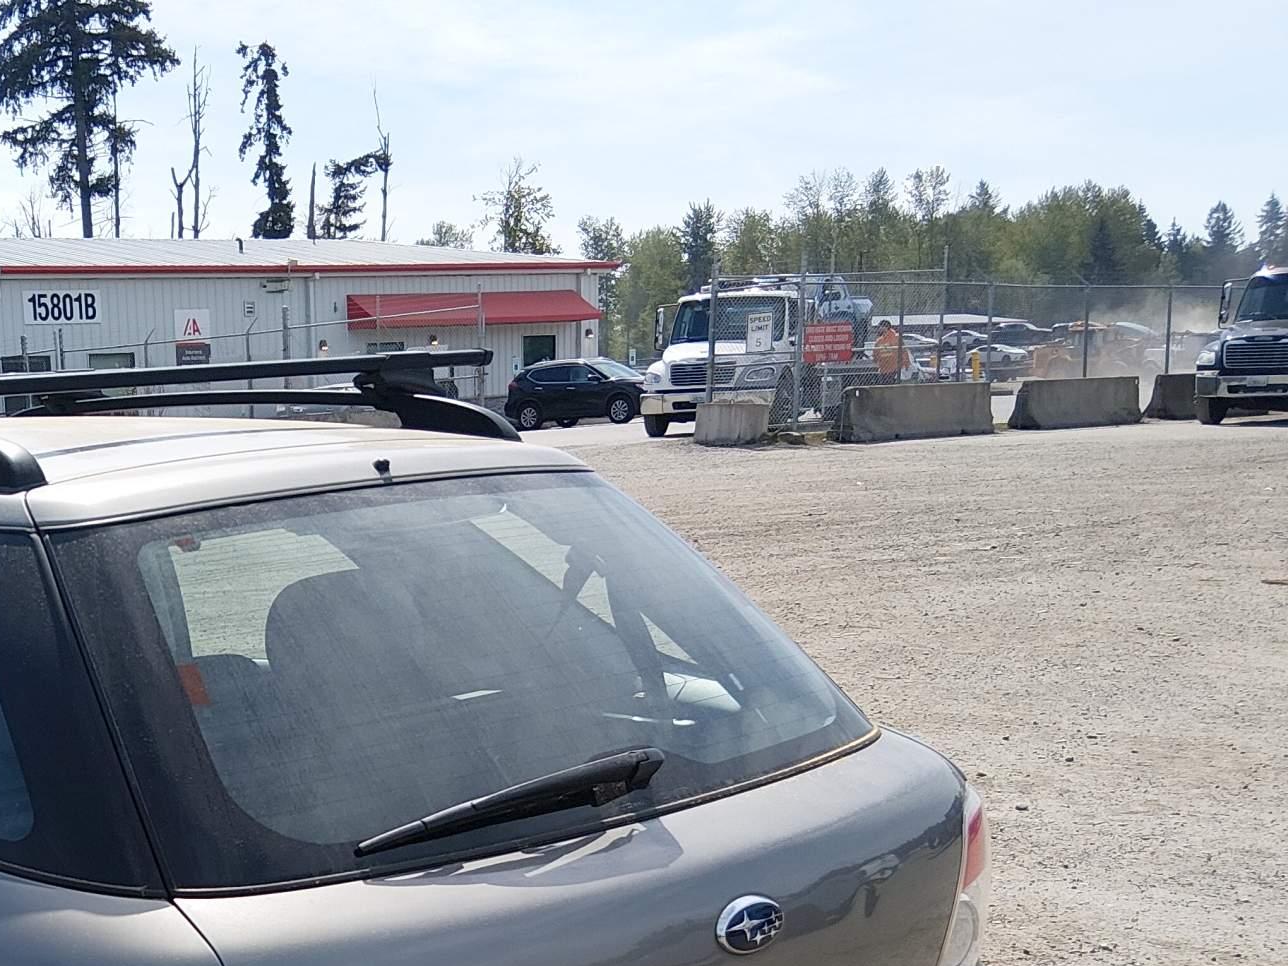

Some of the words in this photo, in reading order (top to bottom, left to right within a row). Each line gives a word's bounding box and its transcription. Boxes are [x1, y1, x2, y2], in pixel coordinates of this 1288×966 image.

[27, 293, 97, 321] 15801B
[750, 315, 772, 324] SPEED
[755, 337, 762, 347] 5
